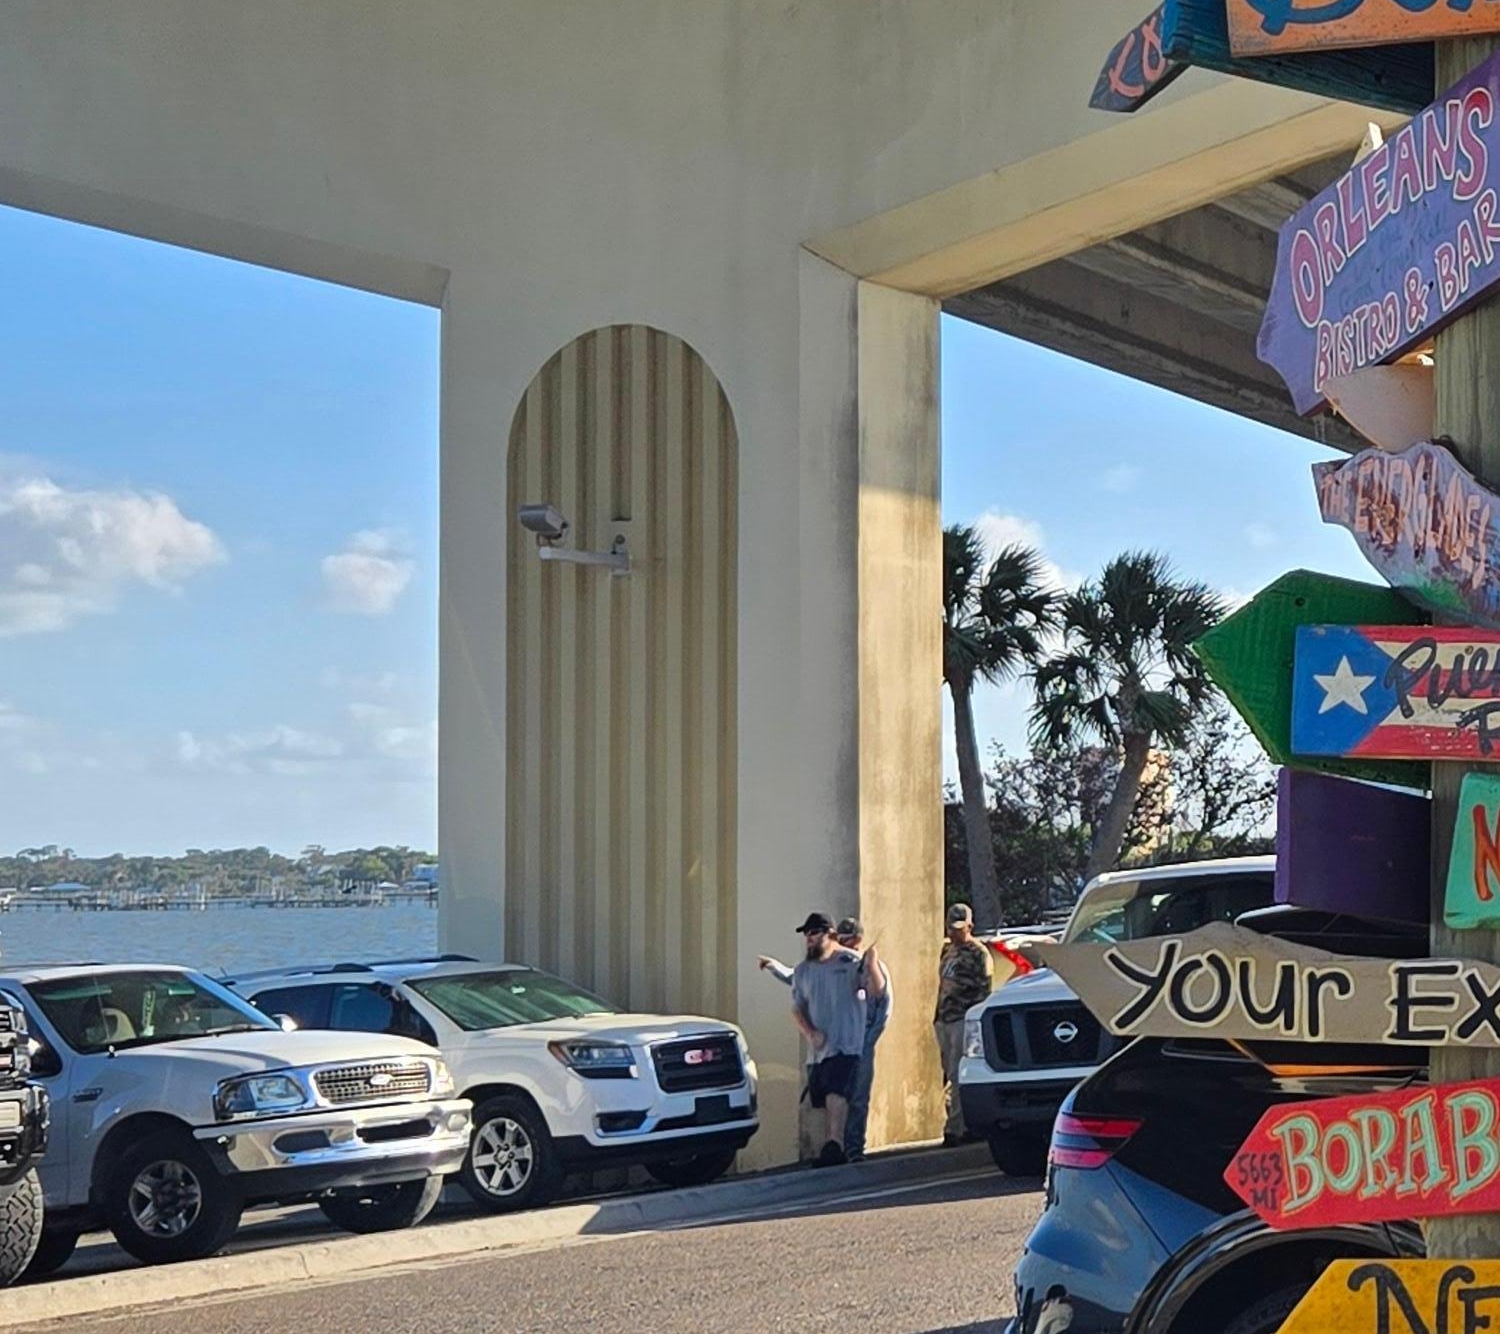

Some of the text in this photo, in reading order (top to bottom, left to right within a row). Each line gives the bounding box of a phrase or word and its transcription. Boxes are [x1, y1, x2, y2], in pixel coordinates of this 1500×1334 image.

[1290, 87, 1493, 327] ORLEANS
[1314, 291, 1400, 393] BISTRO
[1404, 267, 1428, 333] &
[1320, 470, 1352, 523] THE
[1237, 1152, 1284, 1187] 5663
[1249, 1186, 1278, 1211] MI
